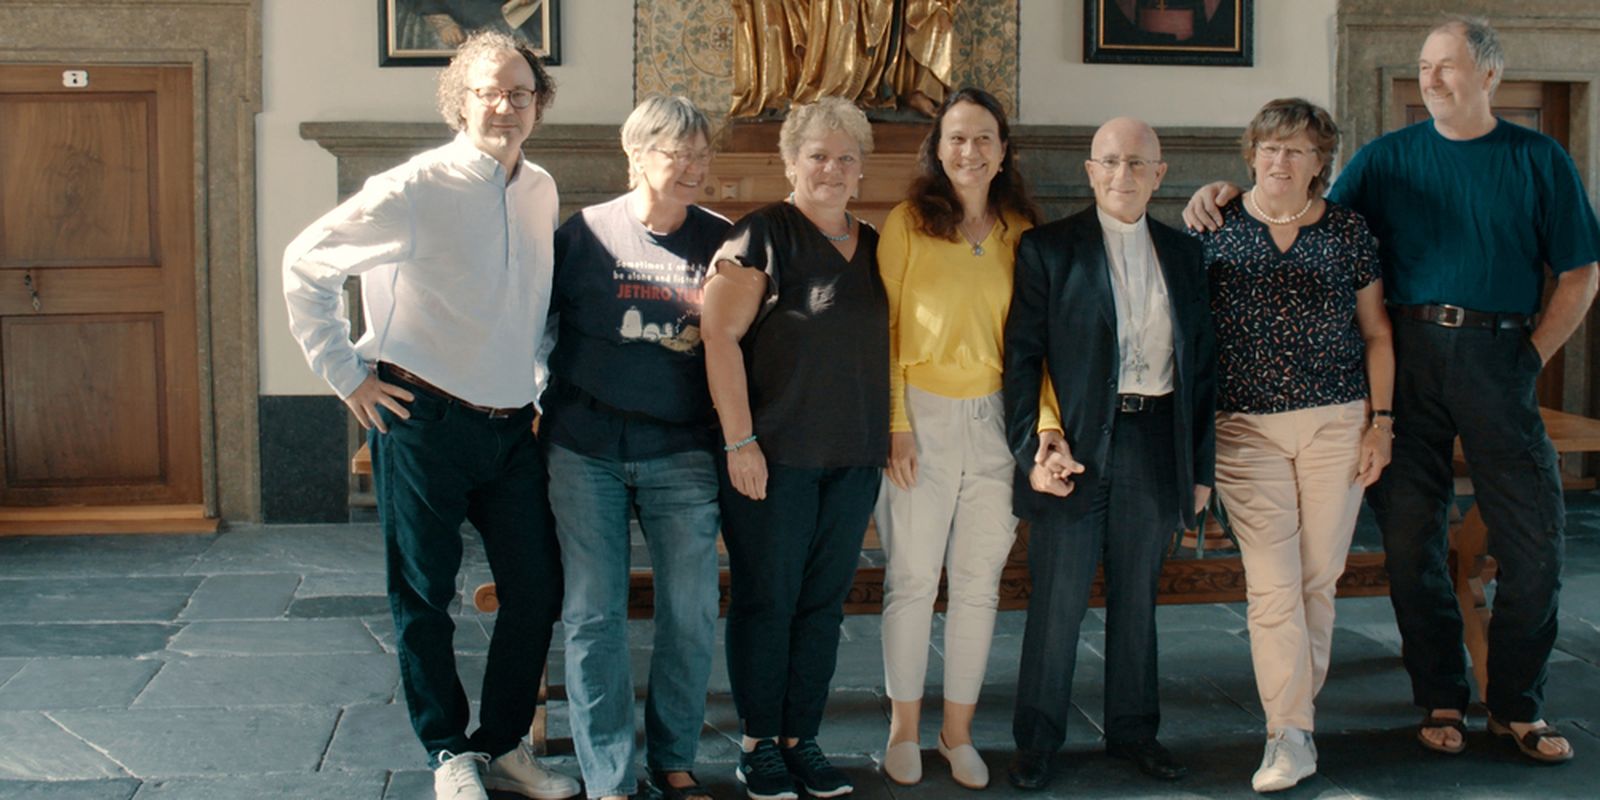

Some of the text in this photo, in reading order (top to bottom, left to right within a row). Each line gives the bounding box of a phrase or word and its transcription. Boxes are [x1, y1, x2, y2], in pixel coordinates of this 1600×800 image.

[616, 260, 664, 271] Sometimes
[613, 270, 624, 279] be
[628, 272, 652, 281] alone
[655, 273, 670, 282] and
[617, 283, 672, 300] JETHRO
